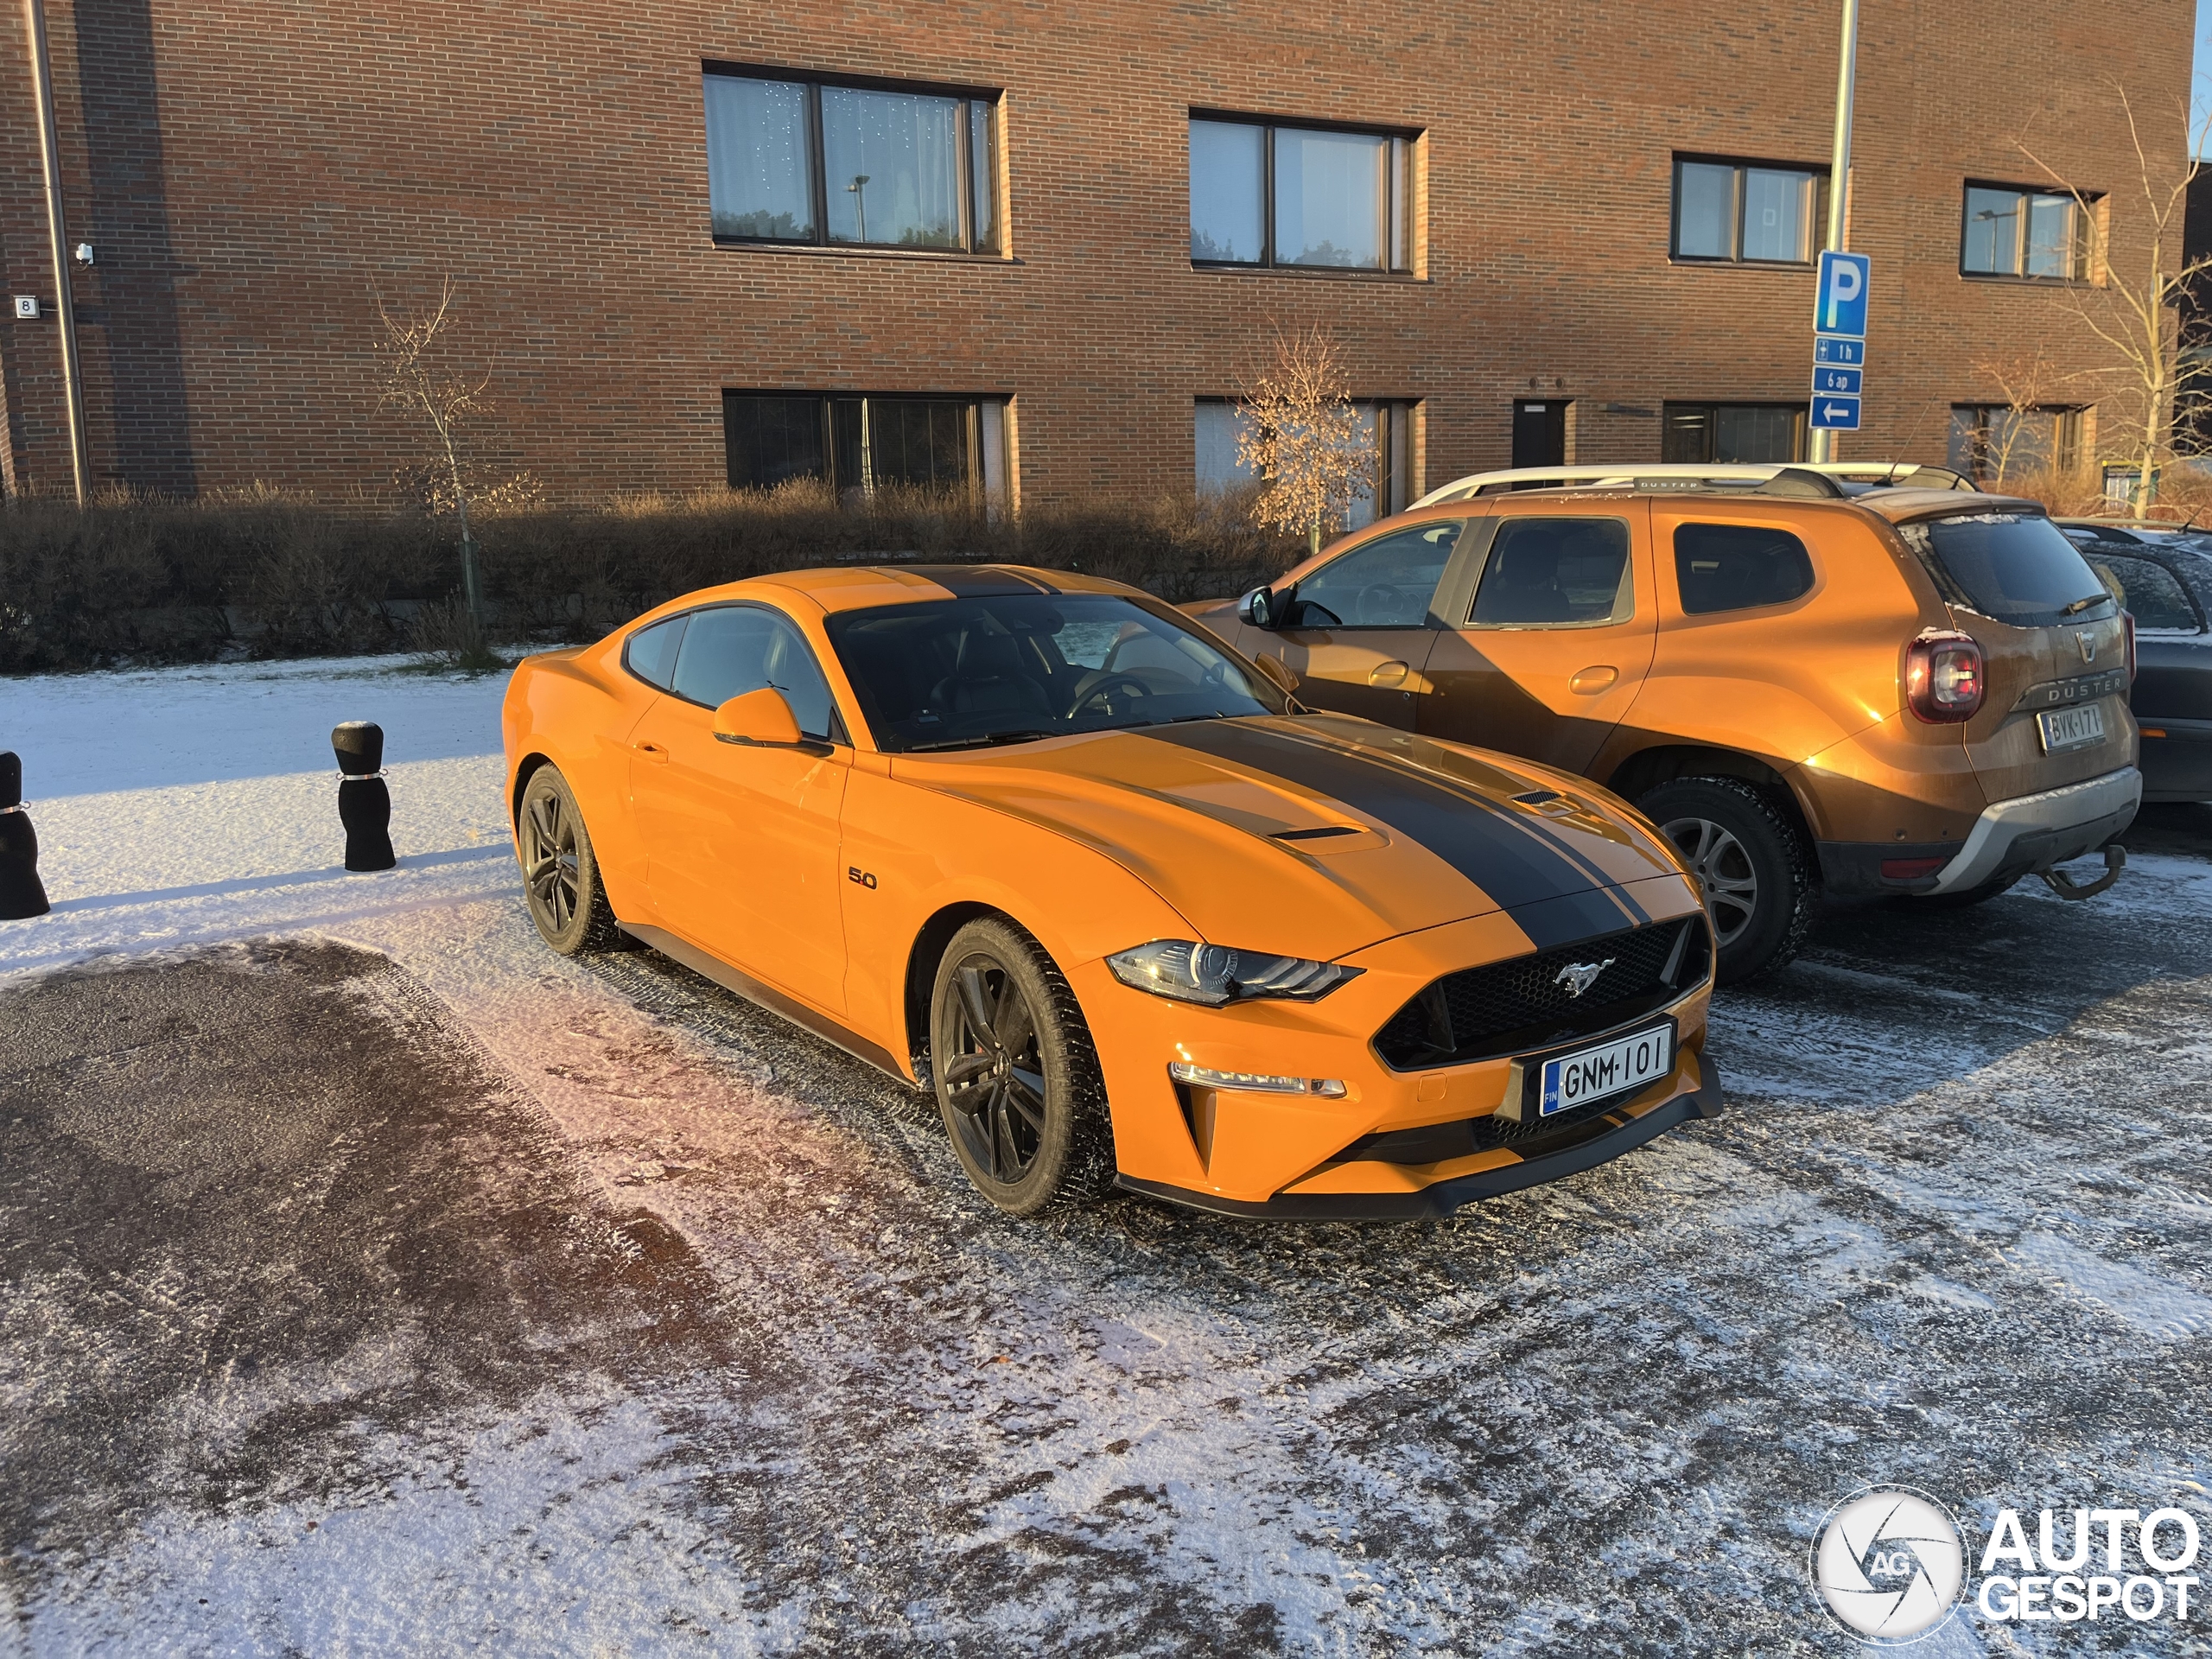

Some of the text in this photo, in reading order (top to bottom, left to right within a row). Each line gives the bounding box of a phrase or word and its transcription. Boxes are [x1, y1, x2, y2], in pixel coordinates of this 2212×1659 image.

[1827, 258, 1862, 328] P
[22, 301, 30, 311] 8
[1839, 343, 1852, 360] 1 h
[1827, 372, 1848, 391] 6 ap
[2049, 677, 2120, 702] DUSTER
[2050, 708, 2101, 741] BVK-171
[1544, 1036, 1661, 1104] FIN GNM-101
